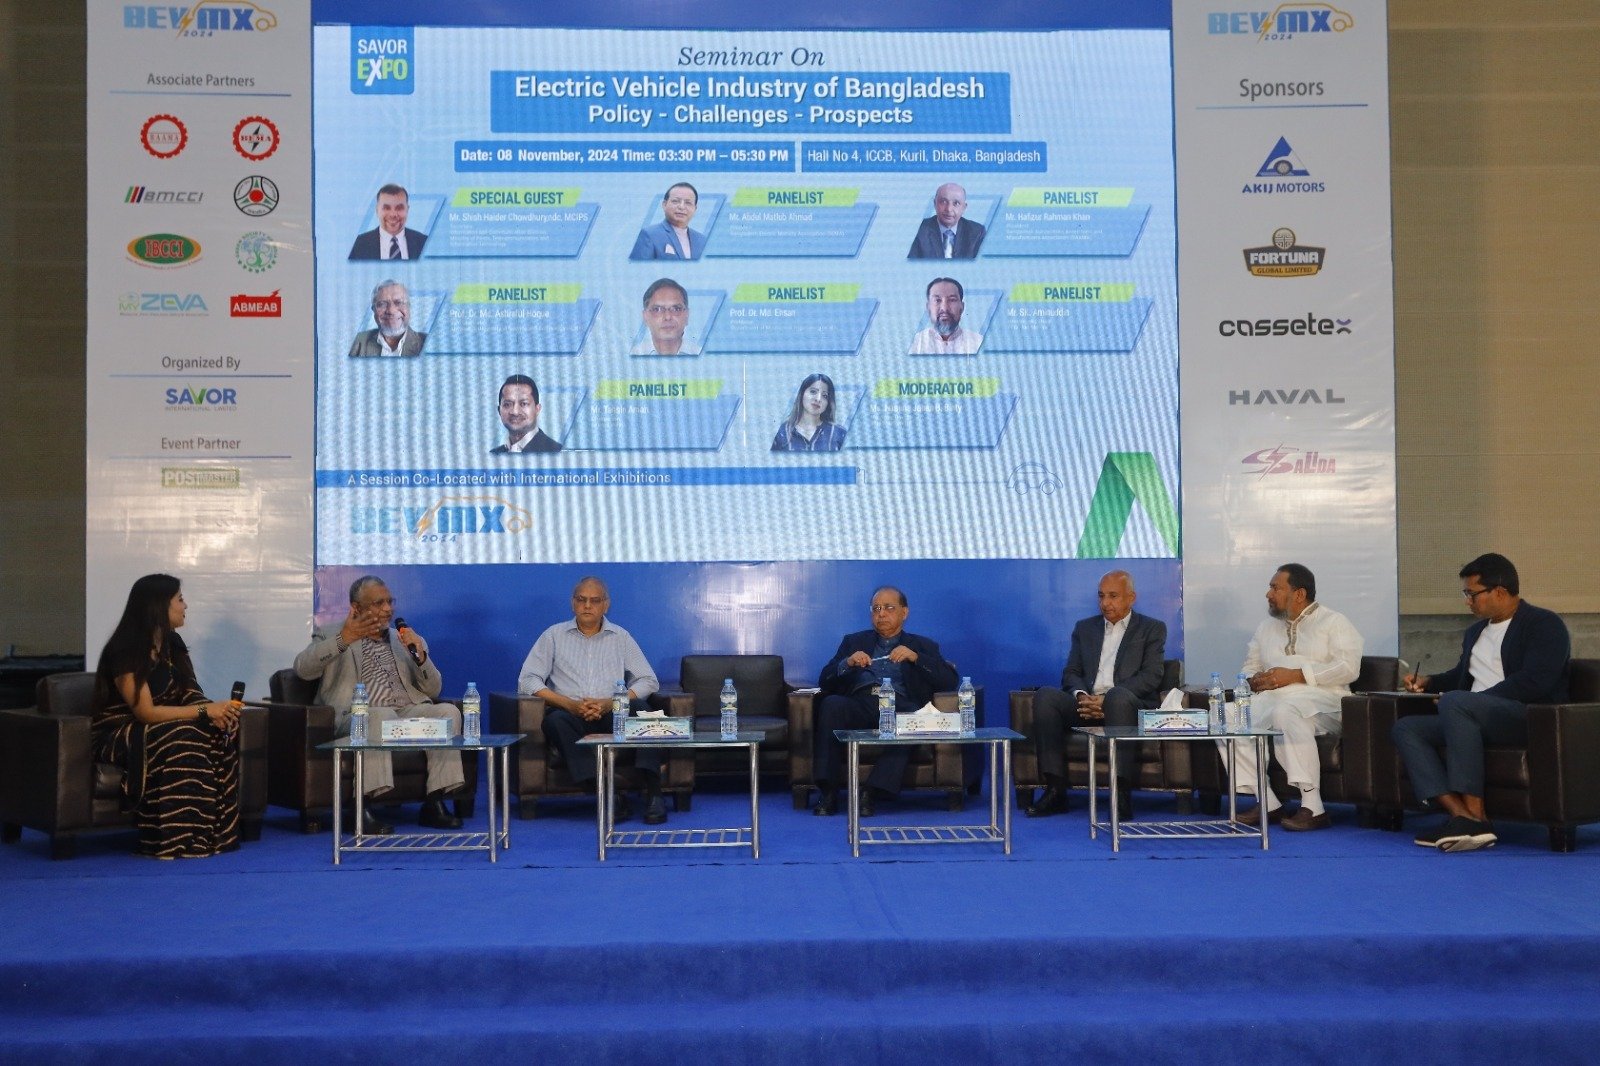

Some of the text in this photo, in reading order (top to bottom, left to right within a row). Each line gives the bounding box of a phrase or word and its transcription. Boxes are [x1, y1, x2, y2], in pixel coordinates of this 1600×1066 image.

[358, 39, 407, 54] SAVOR
[678, 46, 825, 67] Seminar On
[357, 55, 408, 86] EXPO
[147, 73, 255, 87] Associate Partners
[515, 76, 985, 103] Electric Vehicle Industry of Bangladesh
[1239, 78, 1324, 101] Sponsors
[589, 104, 652, 127] Policy
[674, 105, 788, 127] Challenges
[810, 106, 913, 127] Prospects
[461, 149, 492, 162] Date:
[497, 149, 513, 162] 08
[518, 149, 584, 164] November,
[587, 149, 618, 162] 2024
[621, 149, 655, 162] Time:
[658, 149, 693, 162] 03:30
[697, 149, 717, 162] PM
[731, 149, 767, 162] 05:30
[769, 149, 789, 162] PM
[807, 150, 829, 162] Hall
[832, 150, 849, 162] No
[865, 150, 897, 165] ICCB,
[900, 150, 930, 164] Kuril,
[932, 150, 973, 164] Dhaka,
[975, 150, 1041, 166] Bangladesh
[1241, 182, 1325, 194] AKIJ MOTORS
[144, 191, 203, 202] BMCCI
[470, 192, 564, 204] SPECIAL GUEST
[767, 191, 824, 204] PANELIST
[1043, 191, 1098, 204] PANELIST
[145, 239, 183, 257] IBCCI
[1250, 251, 1319, 264] FORTUNA
[1284, 266, 1313, 274] LIMITED
[488, 288, 547, 301] PANELIST
[768, 287, 825, 300] PANELIST
[1044, 287, 1101, 299] PANELIST
[233, 302, 278, 312] ABMEAB
[162, 356, 241, 371] Organized By
[166, 384, 237, 404] SAVOR
[630, 384, 687, 397] PANELIST
[899, 382, 974, 395] MODERATOR
[1229, 388, 1346, 405] HAVAL
[161, 437, 241, 450] Event Partner
[348, 472, 671, 484] A Session Co-Located with International Exhibitions
